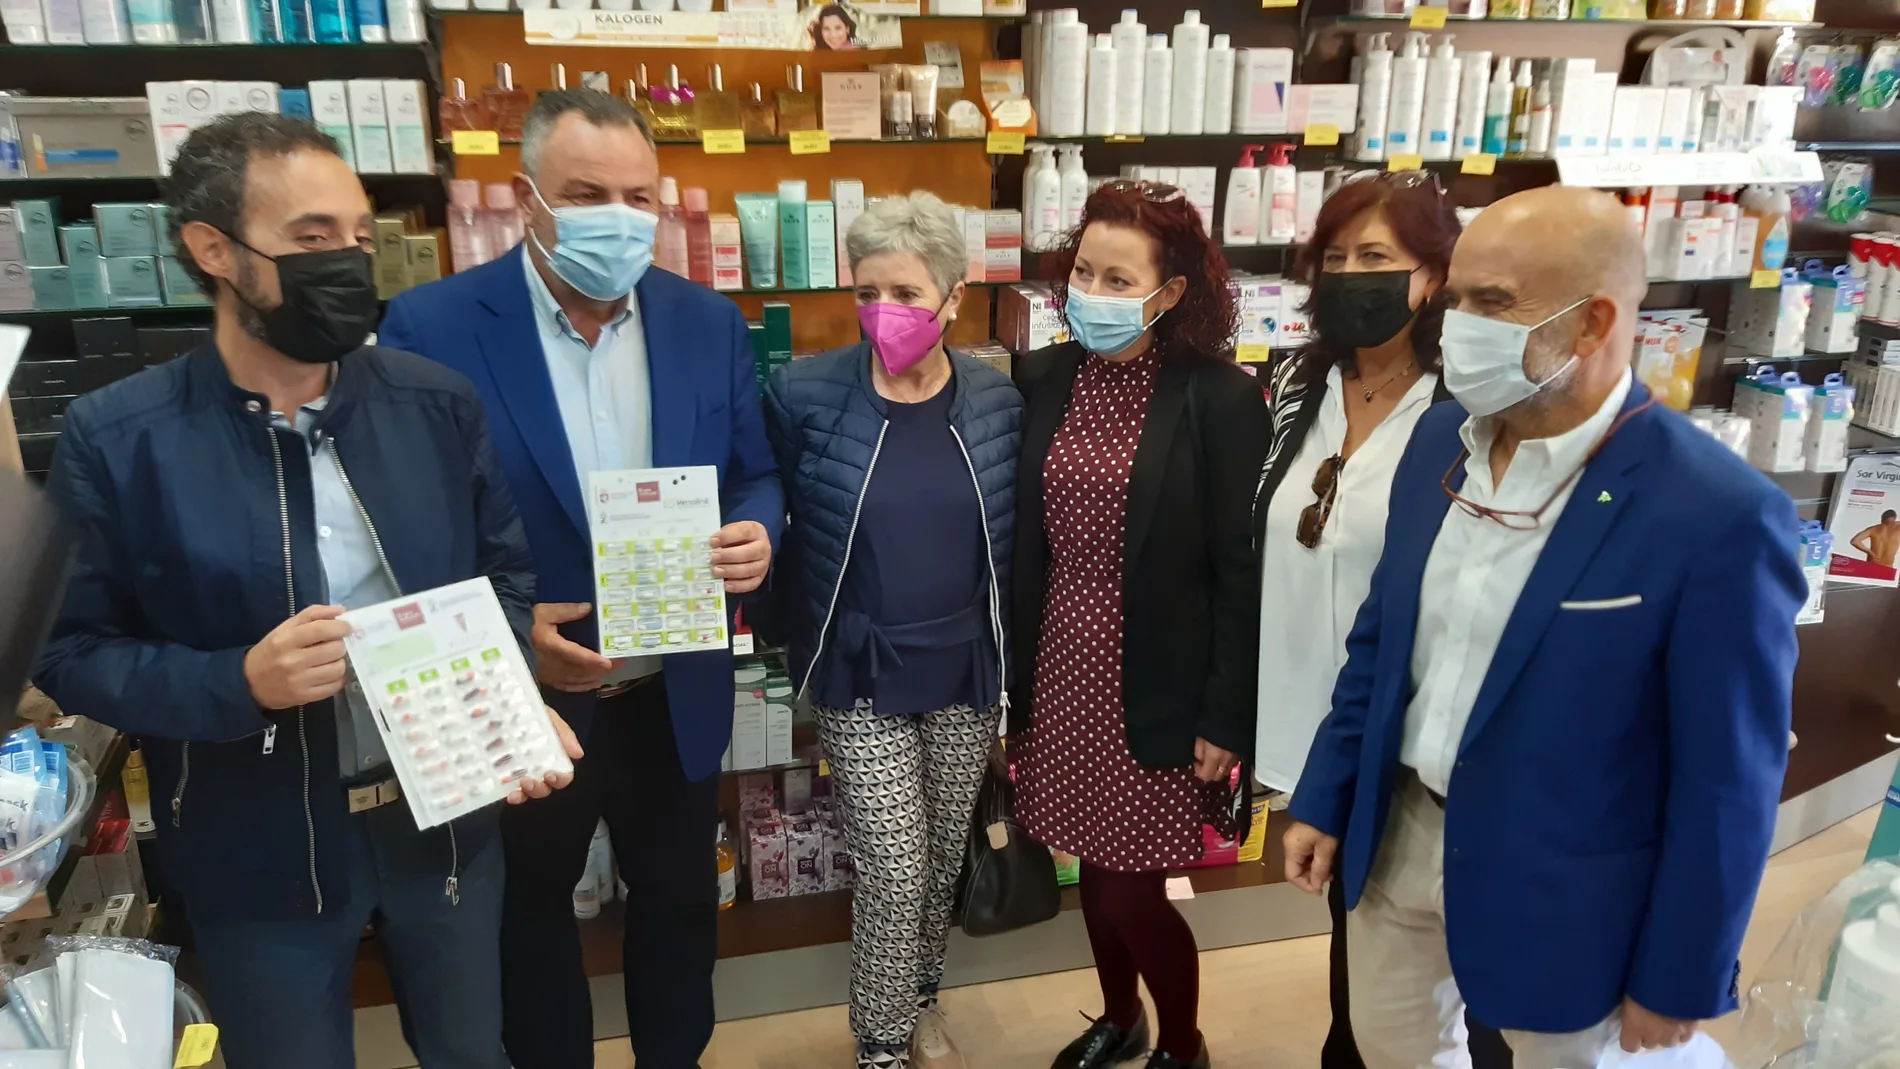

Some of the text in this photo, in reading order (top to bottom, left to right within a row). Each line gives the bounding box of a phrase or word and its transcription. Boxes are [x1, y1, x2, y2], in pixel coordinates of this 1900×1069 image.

[594, 13, 663, 24] KALOGEN
[1856, 470, 1900, 482] Sor Virgi
[800, 861, 813, 869] ON
